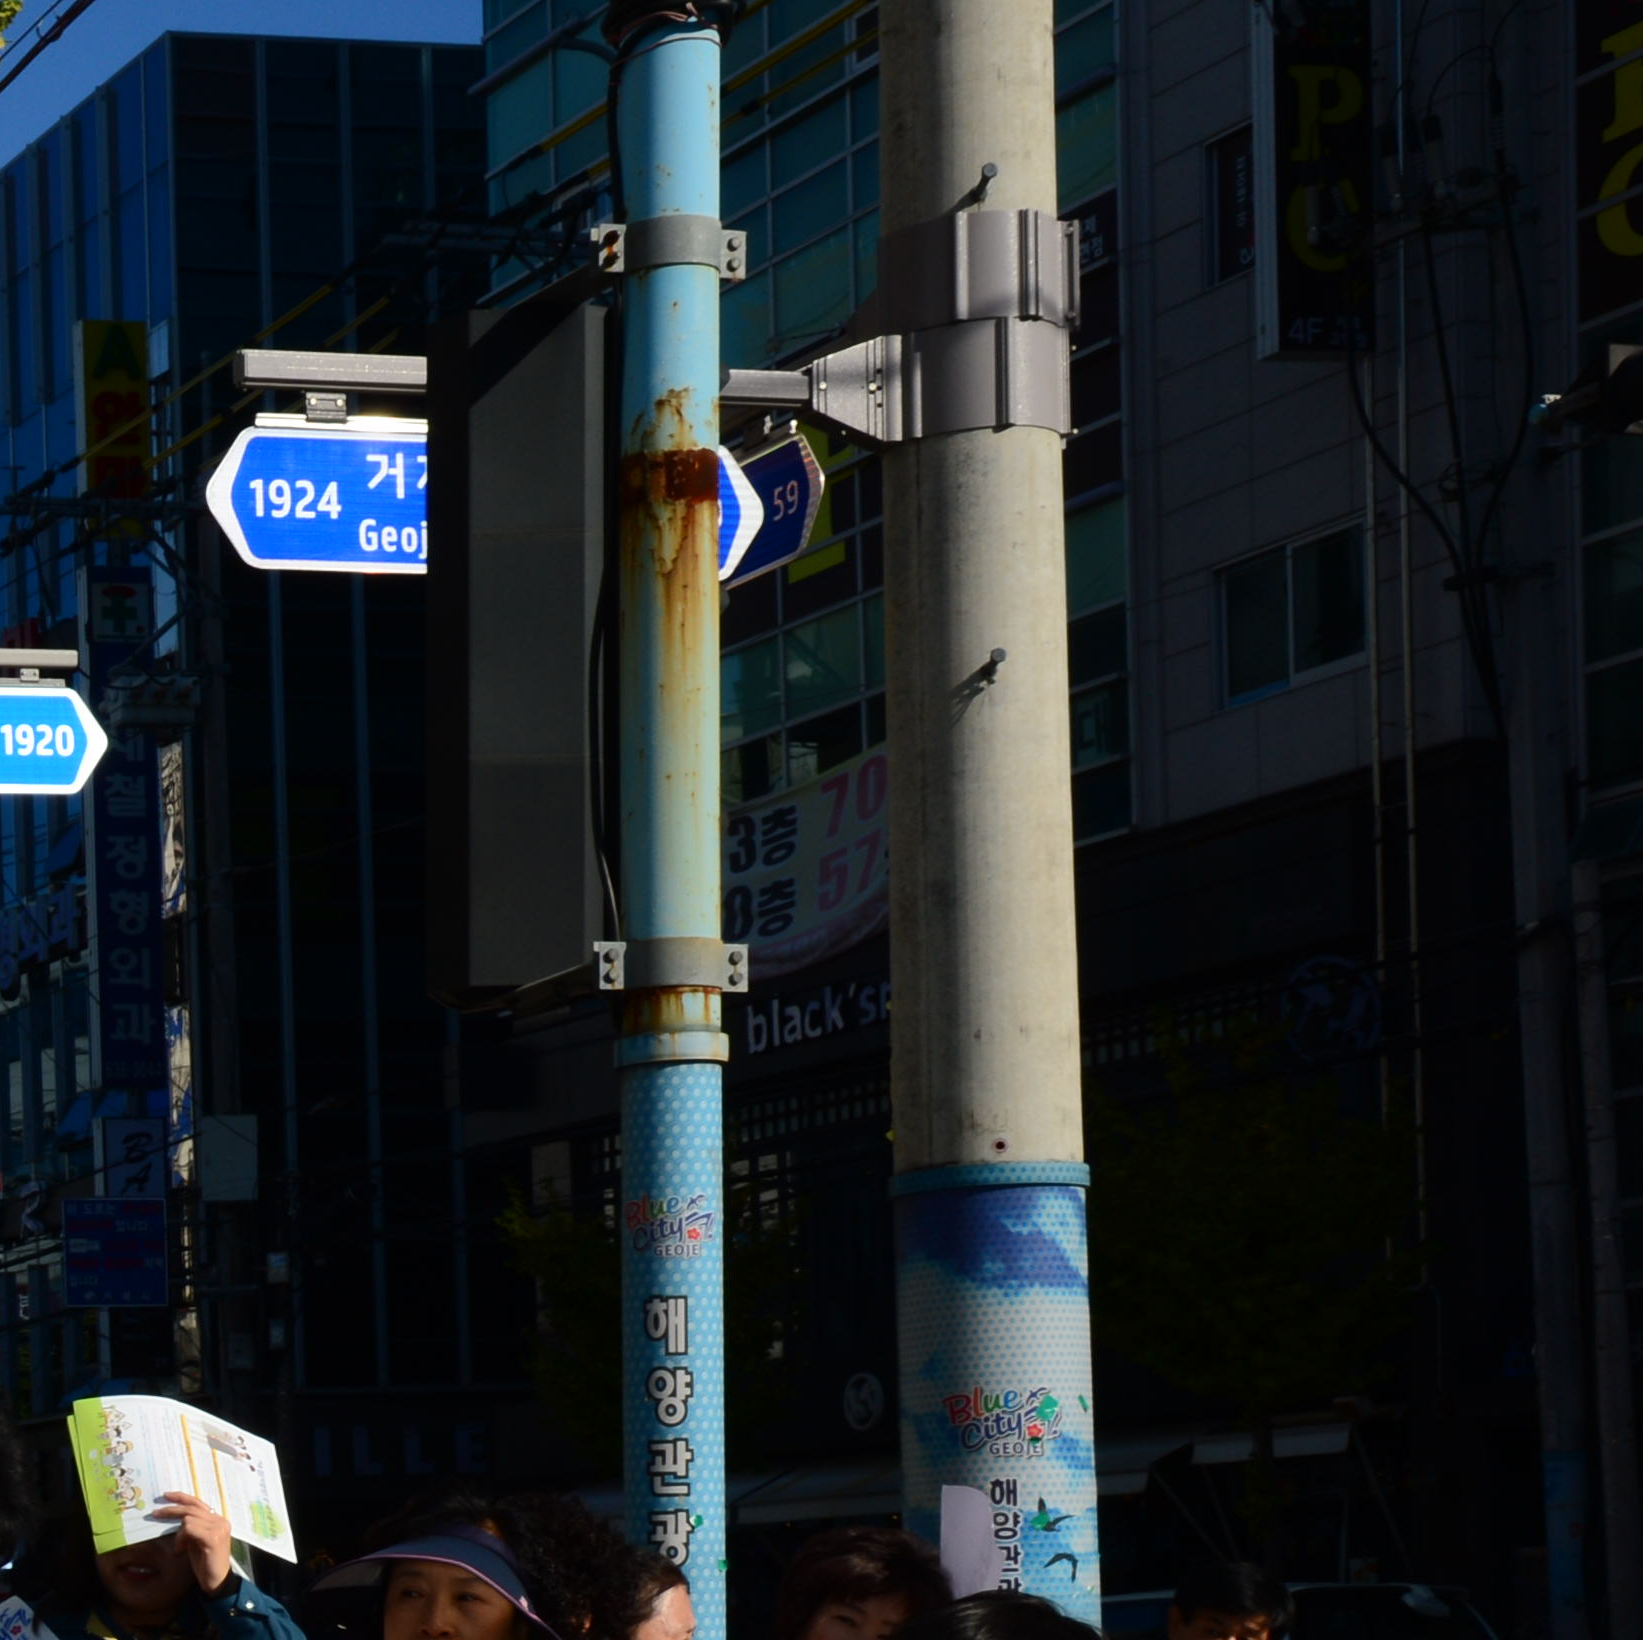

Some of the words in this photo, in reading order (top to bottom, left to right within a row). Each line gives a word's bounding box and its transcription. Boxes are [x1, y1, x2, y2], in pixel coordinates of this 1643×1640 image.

[249, 478, 341, 519] 1924
[359, 518, 427, 562] Geoj
[0, 723, 75, 757] 1920
[943, 1387, 1022, 1425] Blue
[961, 1412, 1023, 1451] City
